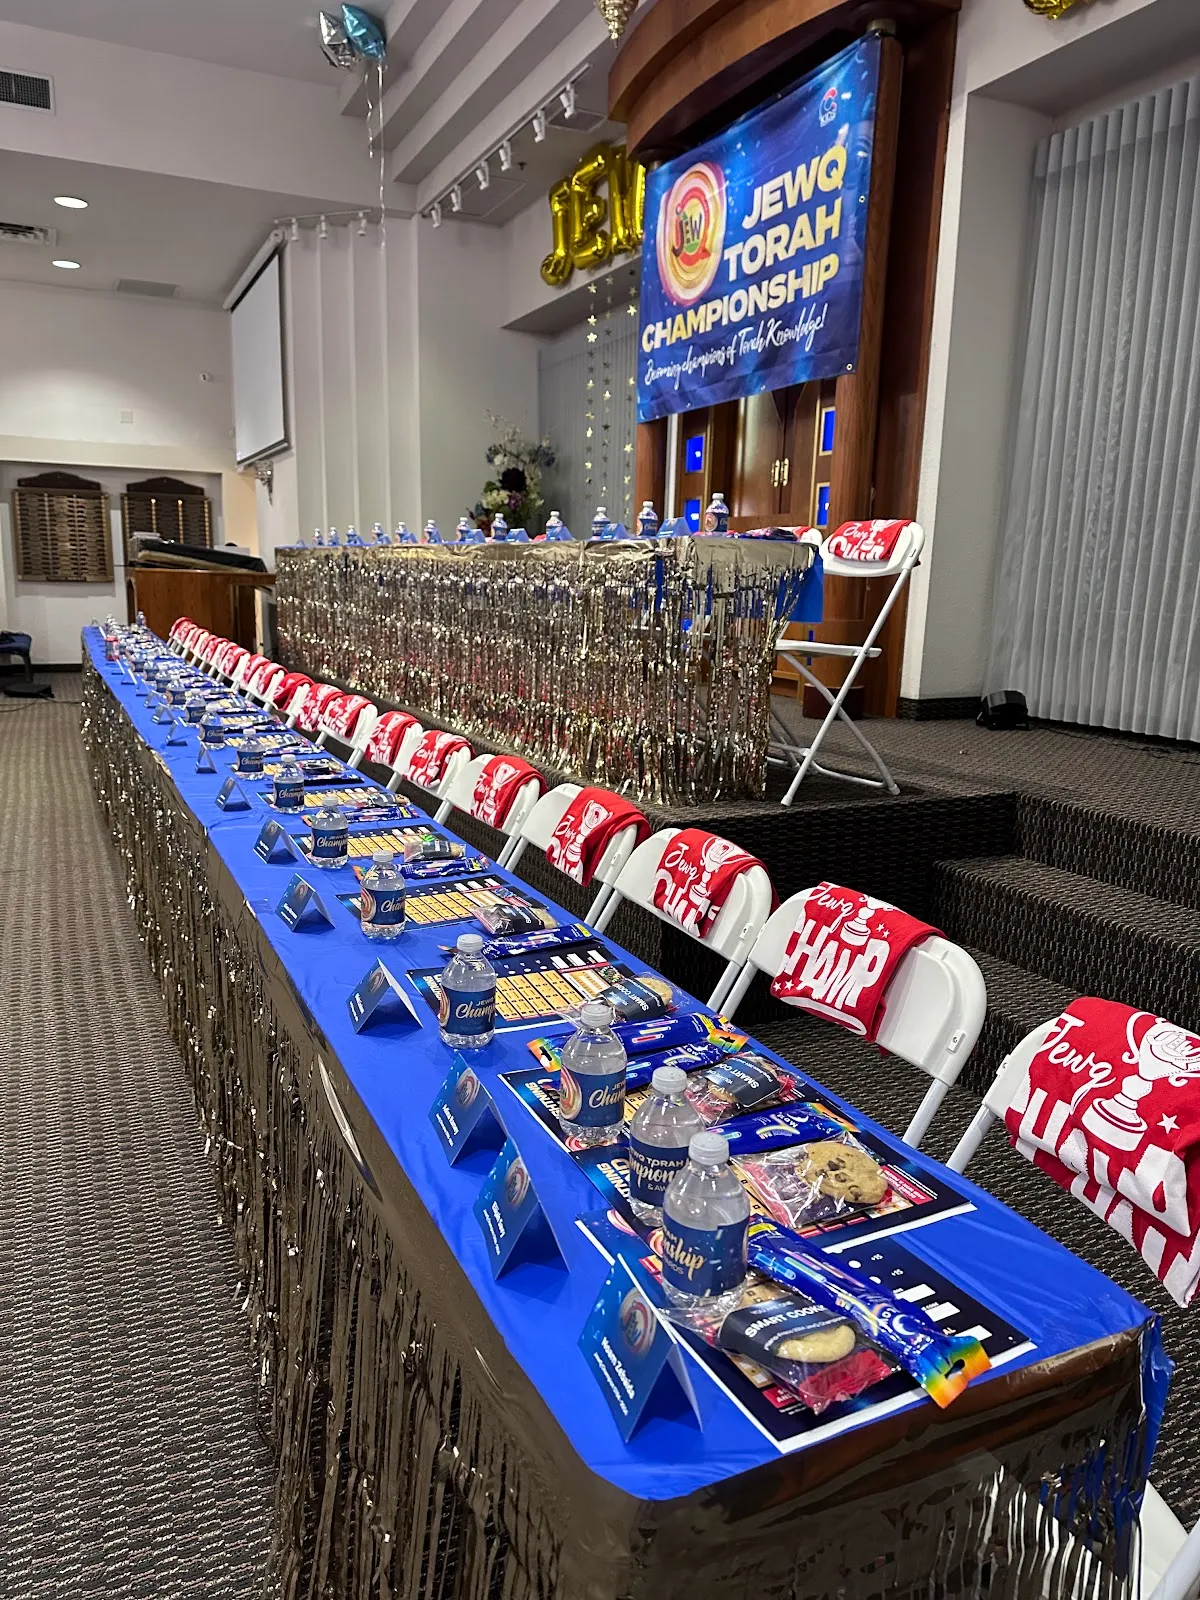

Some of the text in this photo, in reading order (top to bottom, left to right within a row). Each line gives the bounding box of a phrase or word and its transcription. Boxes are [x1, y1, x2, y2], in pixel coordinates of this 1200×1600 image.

[742, 145, 848, 230] JEWQ
[723, 196, 843, 282] TORAH
[641, 253, 840, 353] CHAMPIONSHIP
[681, 345, 726, 378] champions
[725, 334, 737, 365] of
[766, 303, 828, 352] Knowledge!
[730, 1070, 760, 1090] SMART
[646, 1156, 684, 1169] TORAH
[744, 1314, 787, 1338] SMART
